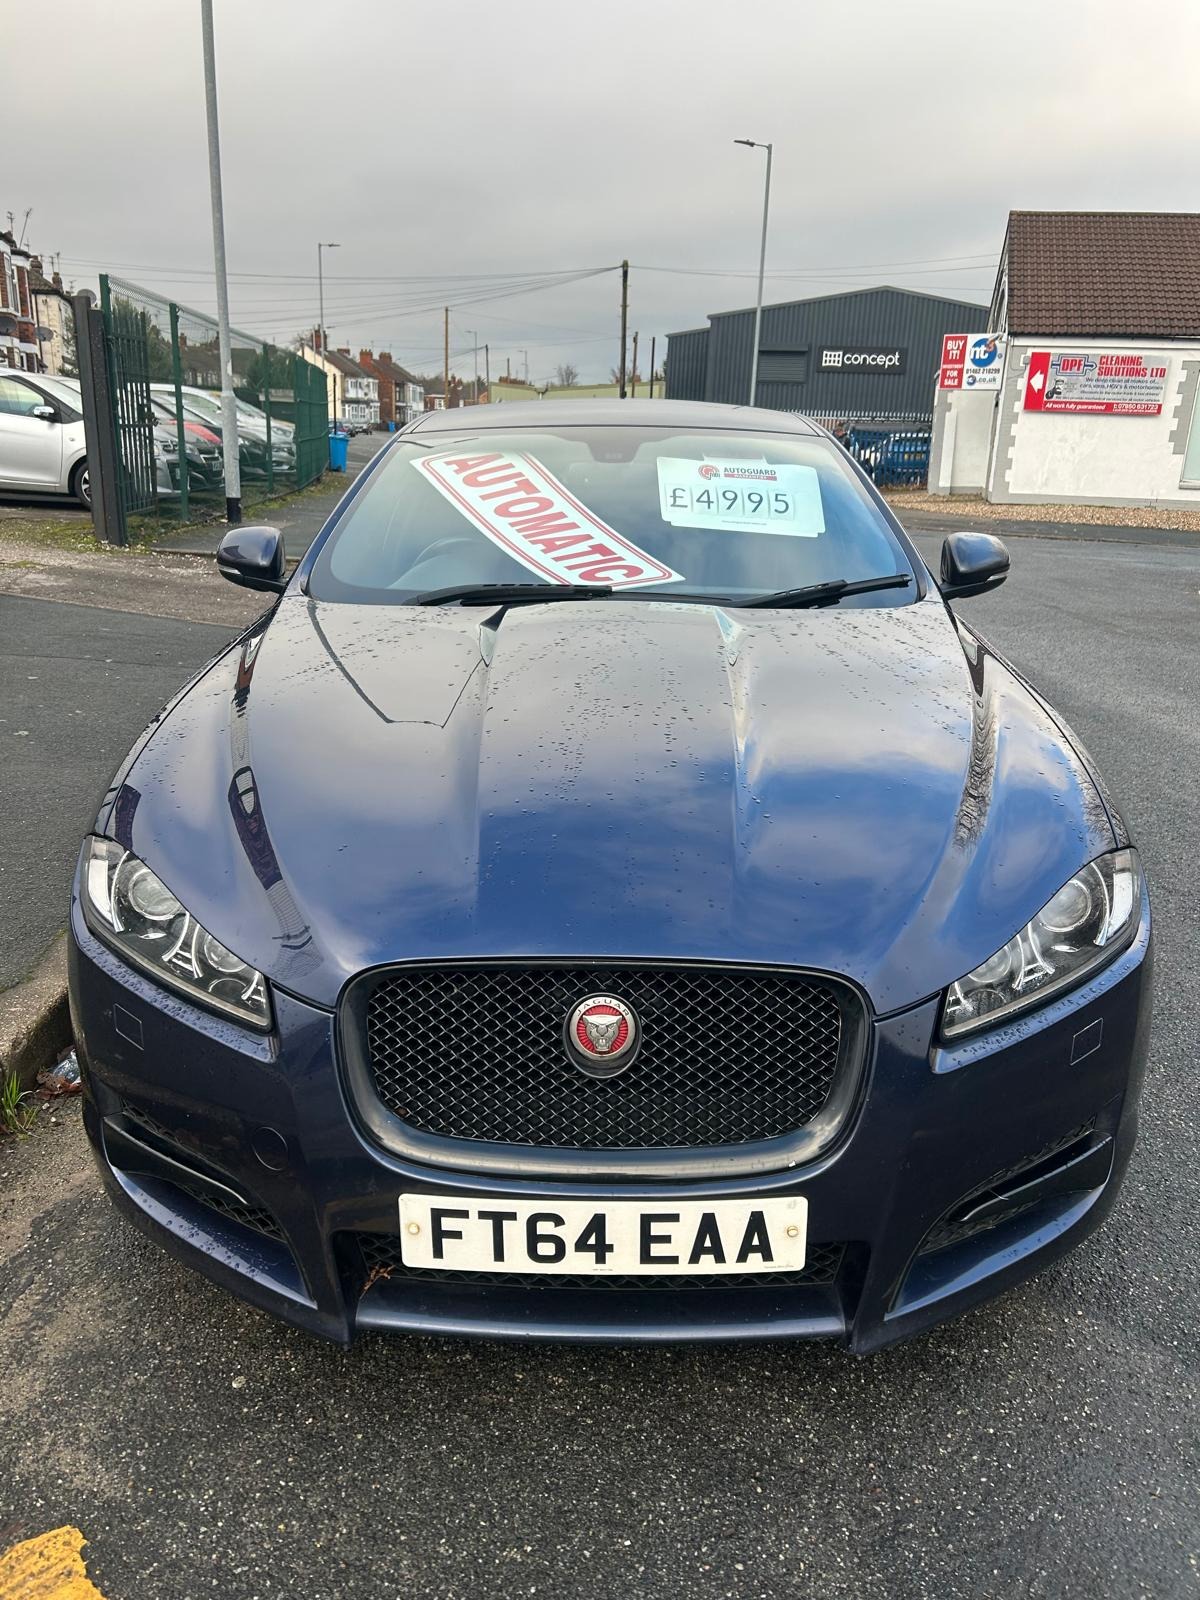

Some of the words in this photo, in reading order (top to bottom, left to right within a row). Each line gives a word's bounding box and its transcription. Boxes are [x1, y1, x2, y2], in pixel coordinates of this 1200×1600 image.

[947, 340, 964, 350] BUY
[844, 352, 900, 369] concept
[949, 350, 960, 360] IT!
[1099, 355, 1143, 366] CLEANING
[1061, 359, 1083, 371] DPF
[946, 370, 958, 378] FOR
[1097, 366, 1148, 378] SOLUTIONS
[1150, 367, 1167, 378] LTD
[944, 378, 959, 386] SALE
[724, 467, 776, 476] AUTOGUARD
[669, 487, 790, 514] £4995
[444, 453, 644, 582] AUTOMATIC
[577, 998, 629, 1017] JAGUAR
[430, 1208, 614, 1264] FT64
[640, 1210, 774, 1265] EAA
